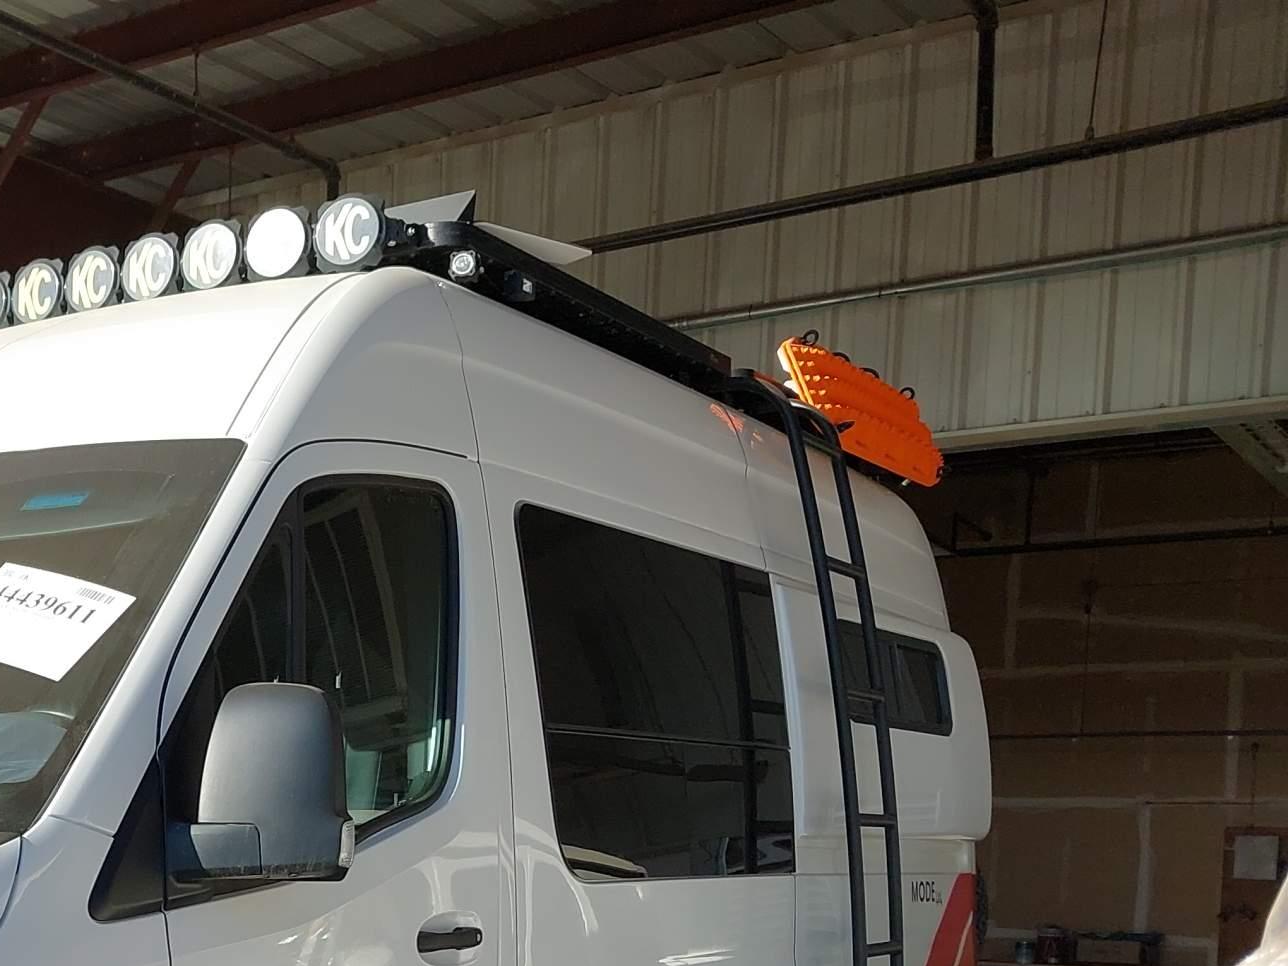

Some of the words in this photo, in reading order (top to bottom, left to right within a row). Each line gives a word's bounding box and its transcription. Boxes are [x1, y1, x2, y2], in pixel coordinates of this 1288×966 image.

[323, 203, 371, 262] KC
[18, 267, 52, 321] KC
[72, 255, 108, 308] KC
[128, 242, 164, 298] KC
[911, 881, 935, 903] MODE
